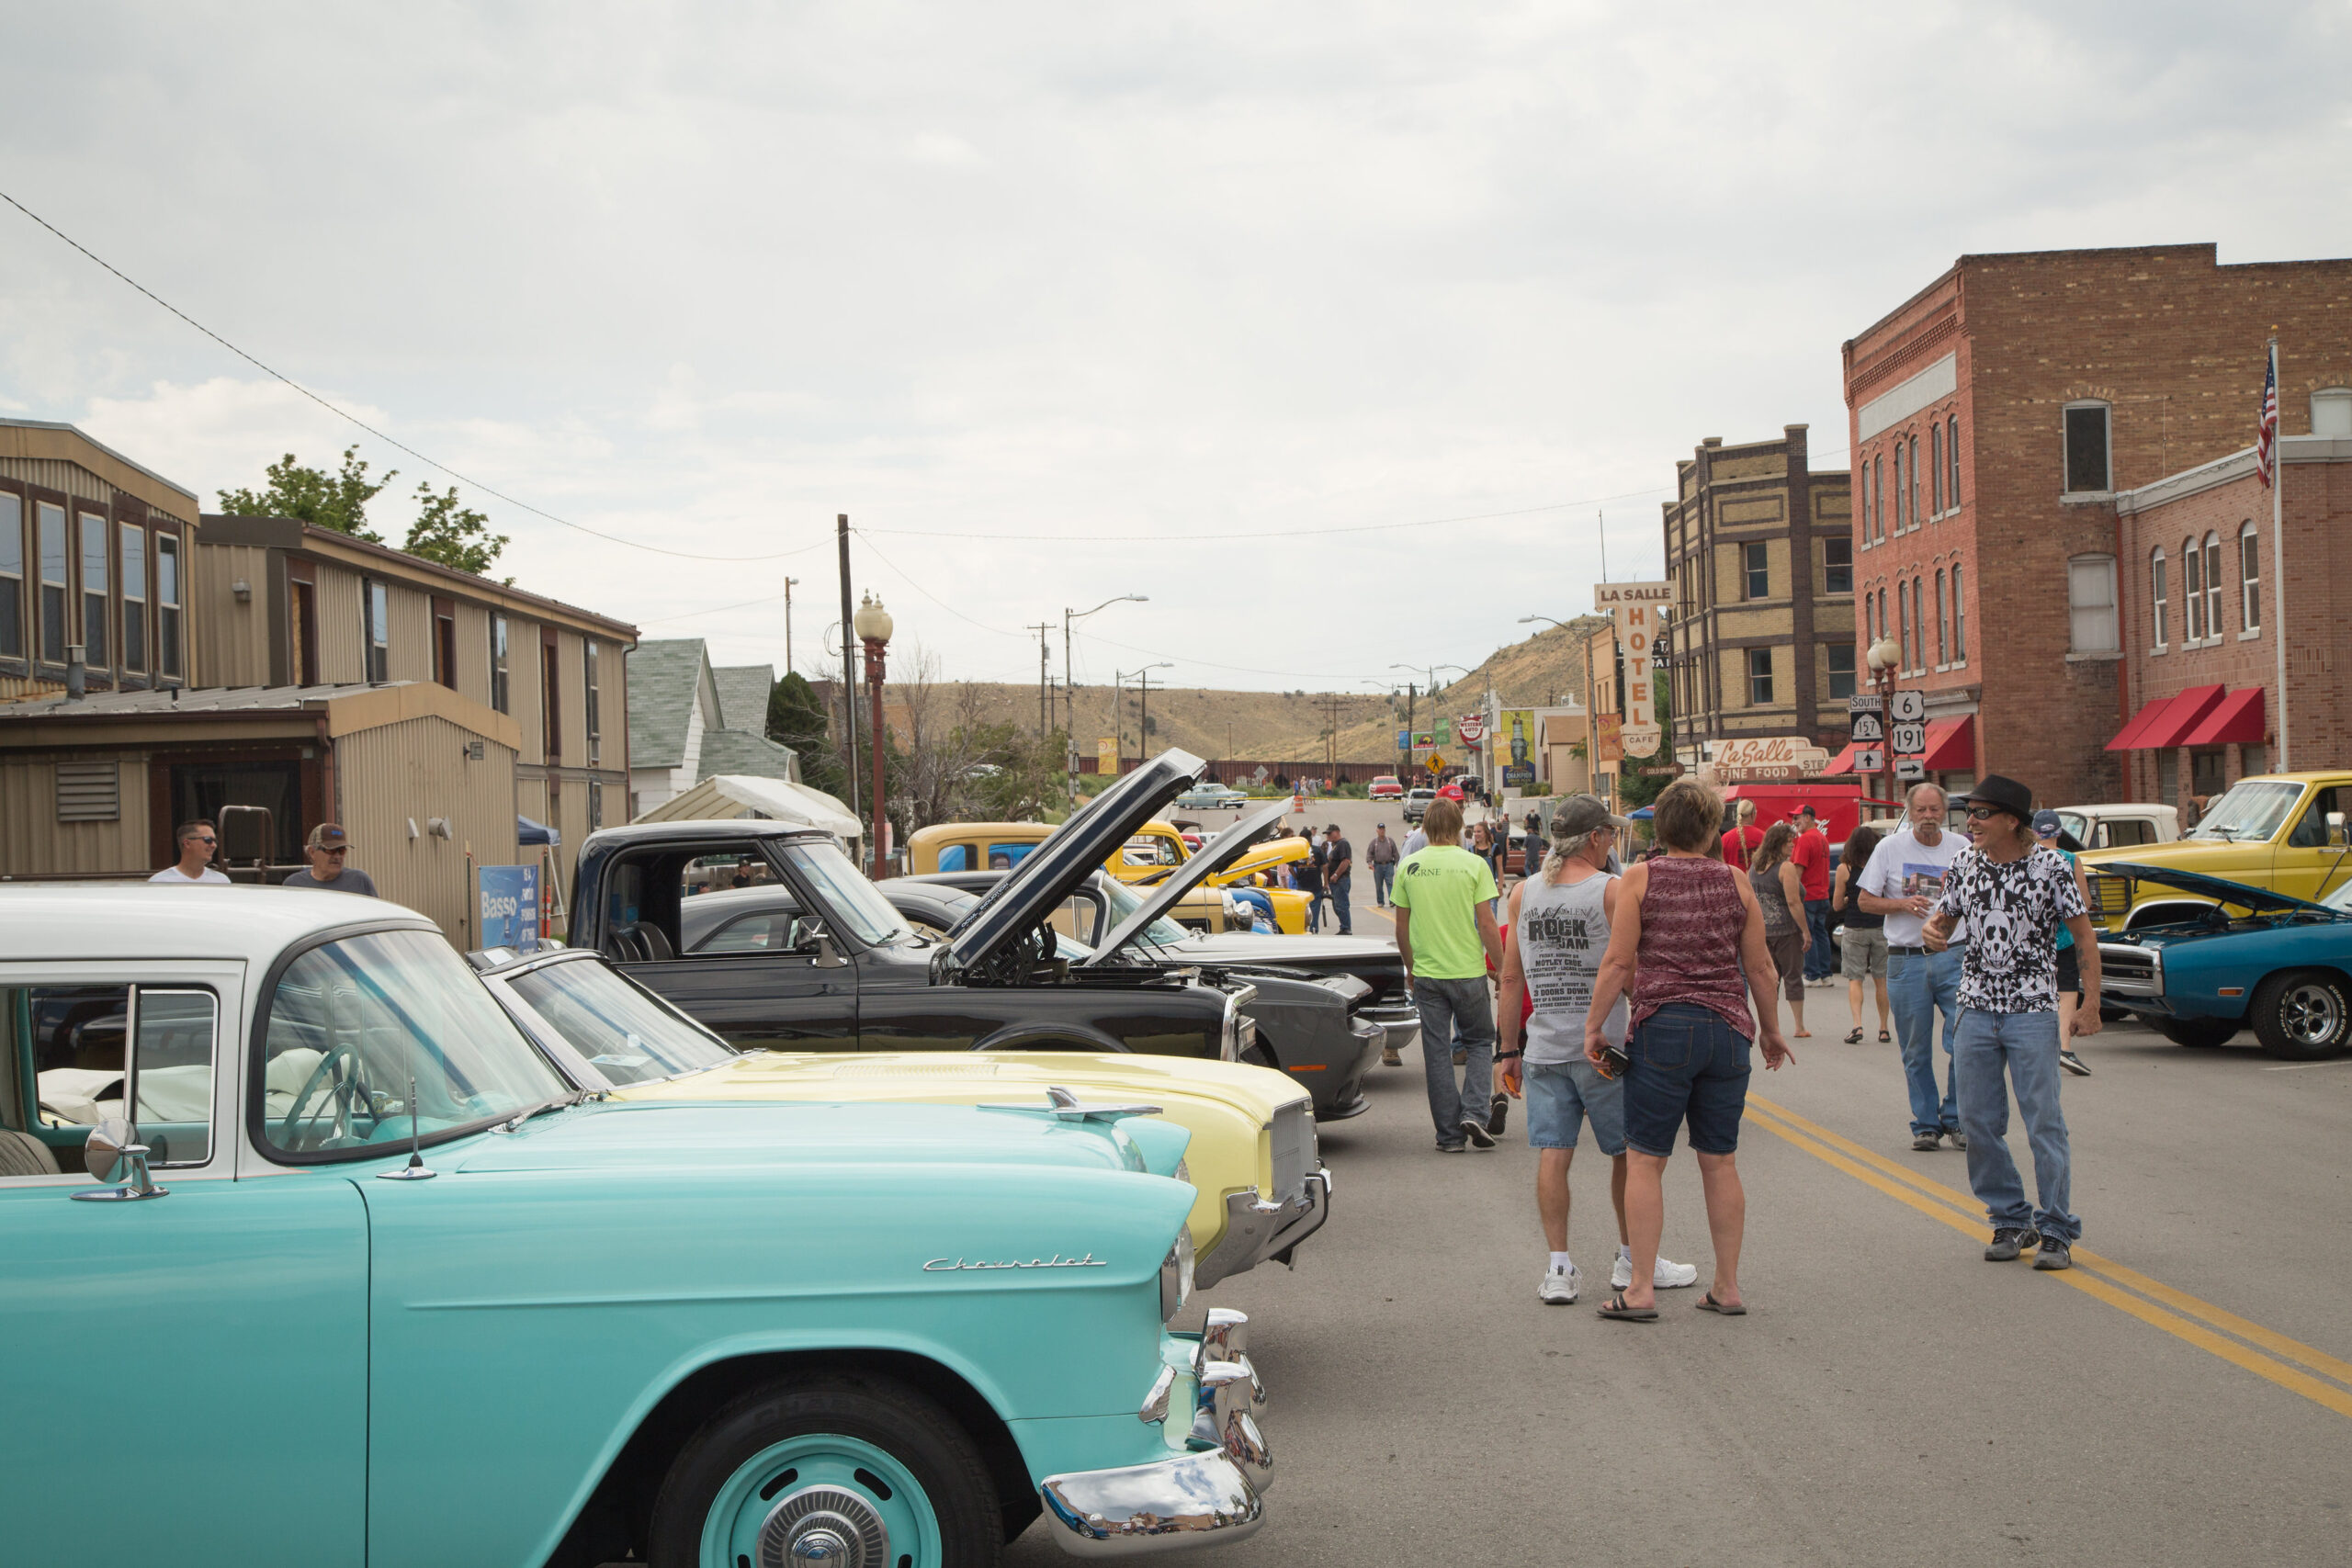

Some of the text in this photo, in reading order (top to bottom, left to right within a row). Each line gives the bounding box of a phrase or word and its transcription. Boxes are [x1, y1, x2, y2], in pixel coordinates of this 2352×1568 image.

[1600, 588, 1671, 602] LA SALLE
[1629, 607, 1648, 726] HOTEL
[1852, 696, 1881, 707] SOUTH
[1903, 697, 1913, 714] 6
[1859, 721, 1875, 733] 157
[1629, 736, 1654, 744] CAFE
[1896, 729, 1921, 748] 191
[1720, 767, 1790, 780] FINE FOOD
[481, 891, 517, 919] Basso
[961, 882, 1009, 928] COWL INDUCTION
[1528, 919, 1588, 942] ROCK
[1559, 937, 1589, 950] JAM
[1541, 987, 1565, 996] DOORS
[2328, 985, 2347, 1016] COOPER
[2330, 1018, 2346, 1043] COBRA
[922, 1253, 1106, 1271] Chevrolet
